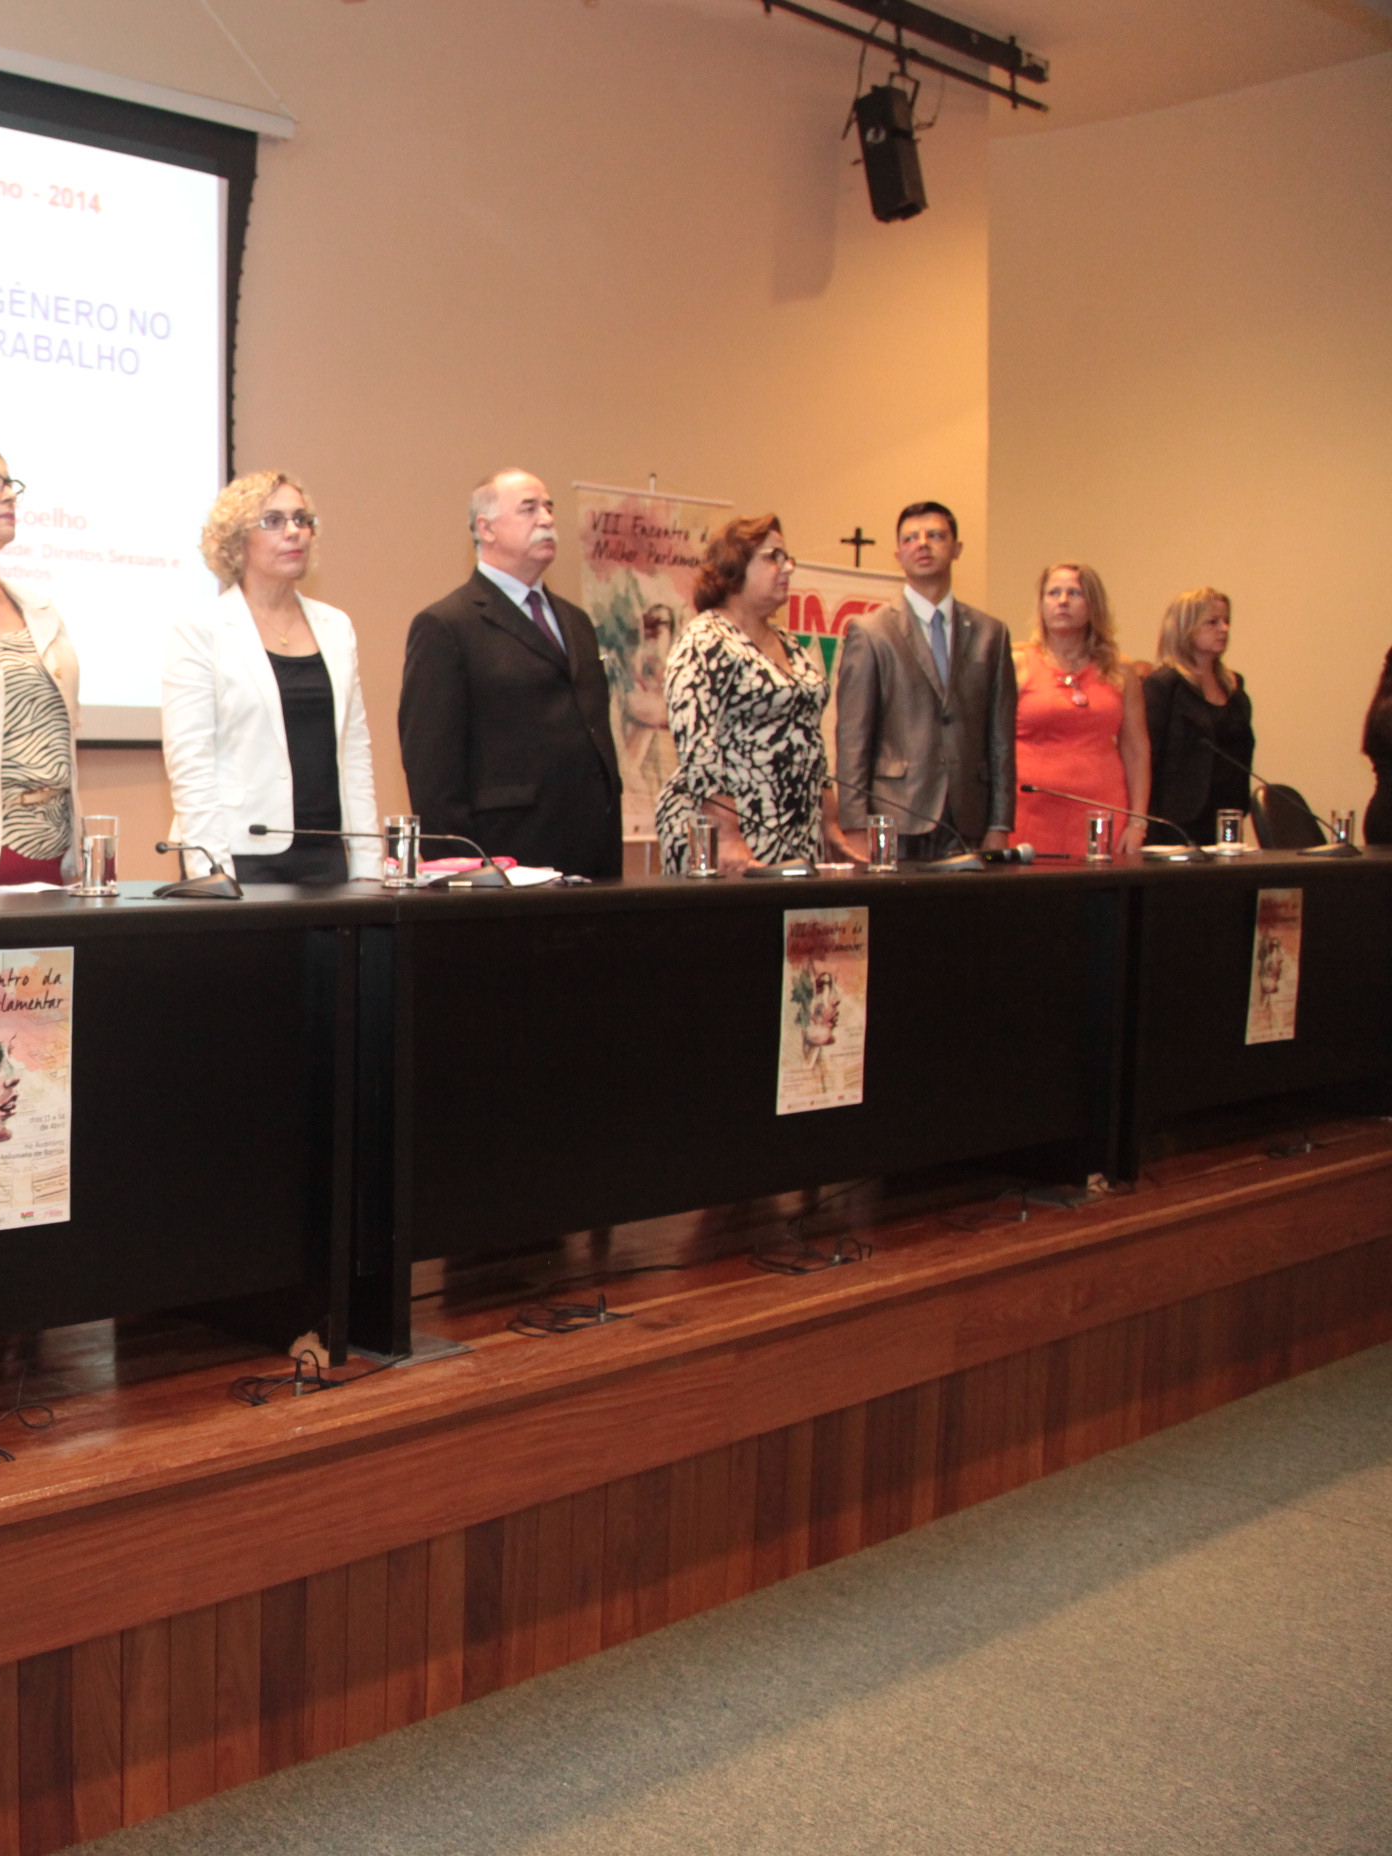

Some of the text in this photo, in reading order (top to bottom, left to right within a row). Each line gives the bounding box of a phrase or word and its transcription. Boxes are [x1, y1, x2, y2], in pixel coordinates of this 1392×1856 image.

[48, 185, 102, 214] 2014
[129, 309, 172, 340] NO
[15, 505, 87, 530] oelho
[592, 511, 622, 535] VII
[648, 541, 702, 567] Parlamen
[42, 967, 62, 986] da
